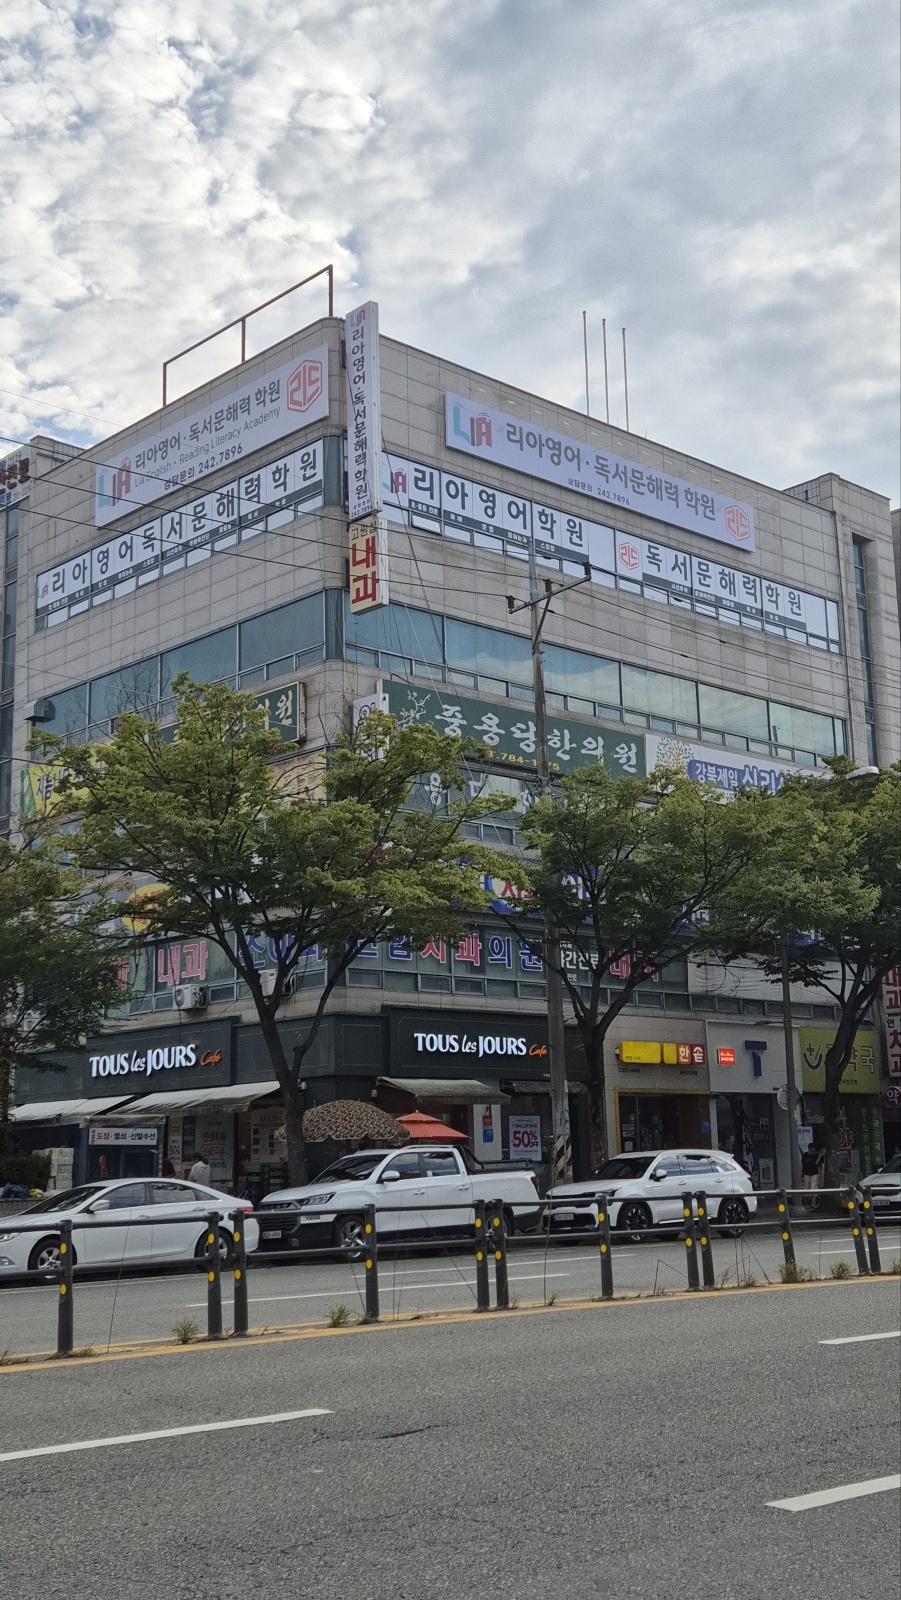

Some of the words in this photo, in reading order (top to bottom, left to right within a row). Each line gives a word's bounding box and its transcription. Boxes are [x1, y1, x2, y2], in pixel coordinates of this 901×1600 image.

[254, 378, 281, 408] 학원
[452, 402, 493, 448] LIA
[134, 472, 145, 488] Lia
[146, 459, 172, 479] English
[179, 442, 210, 466] Reading
[211, 425, 242, 449] Literacy
[243, 406, 281, 433] Academy
[197, 444, 243, 474] 242.7896
[98, 458, 131, 509] LIA
[597, 487, 630, 506] 242.7896
[683, 487, 716, 521] 학원
[351, 535, 379, 604] 내과
[695, 763, 738, 789] 강북제일
[157, 941, 209, 986] 내과
[89, 1052, 130, 1077] TOUS
[131, 1050, 146, 1072] les
[146, 1043, 197, 1076] JOURS
[414, 1033, 460, 1053] TOUS
[461, 1035, 477, 1053] les
[478, 1036, 527, 1058] JOURS
[679, 1045, 704, 1063] 한솥
